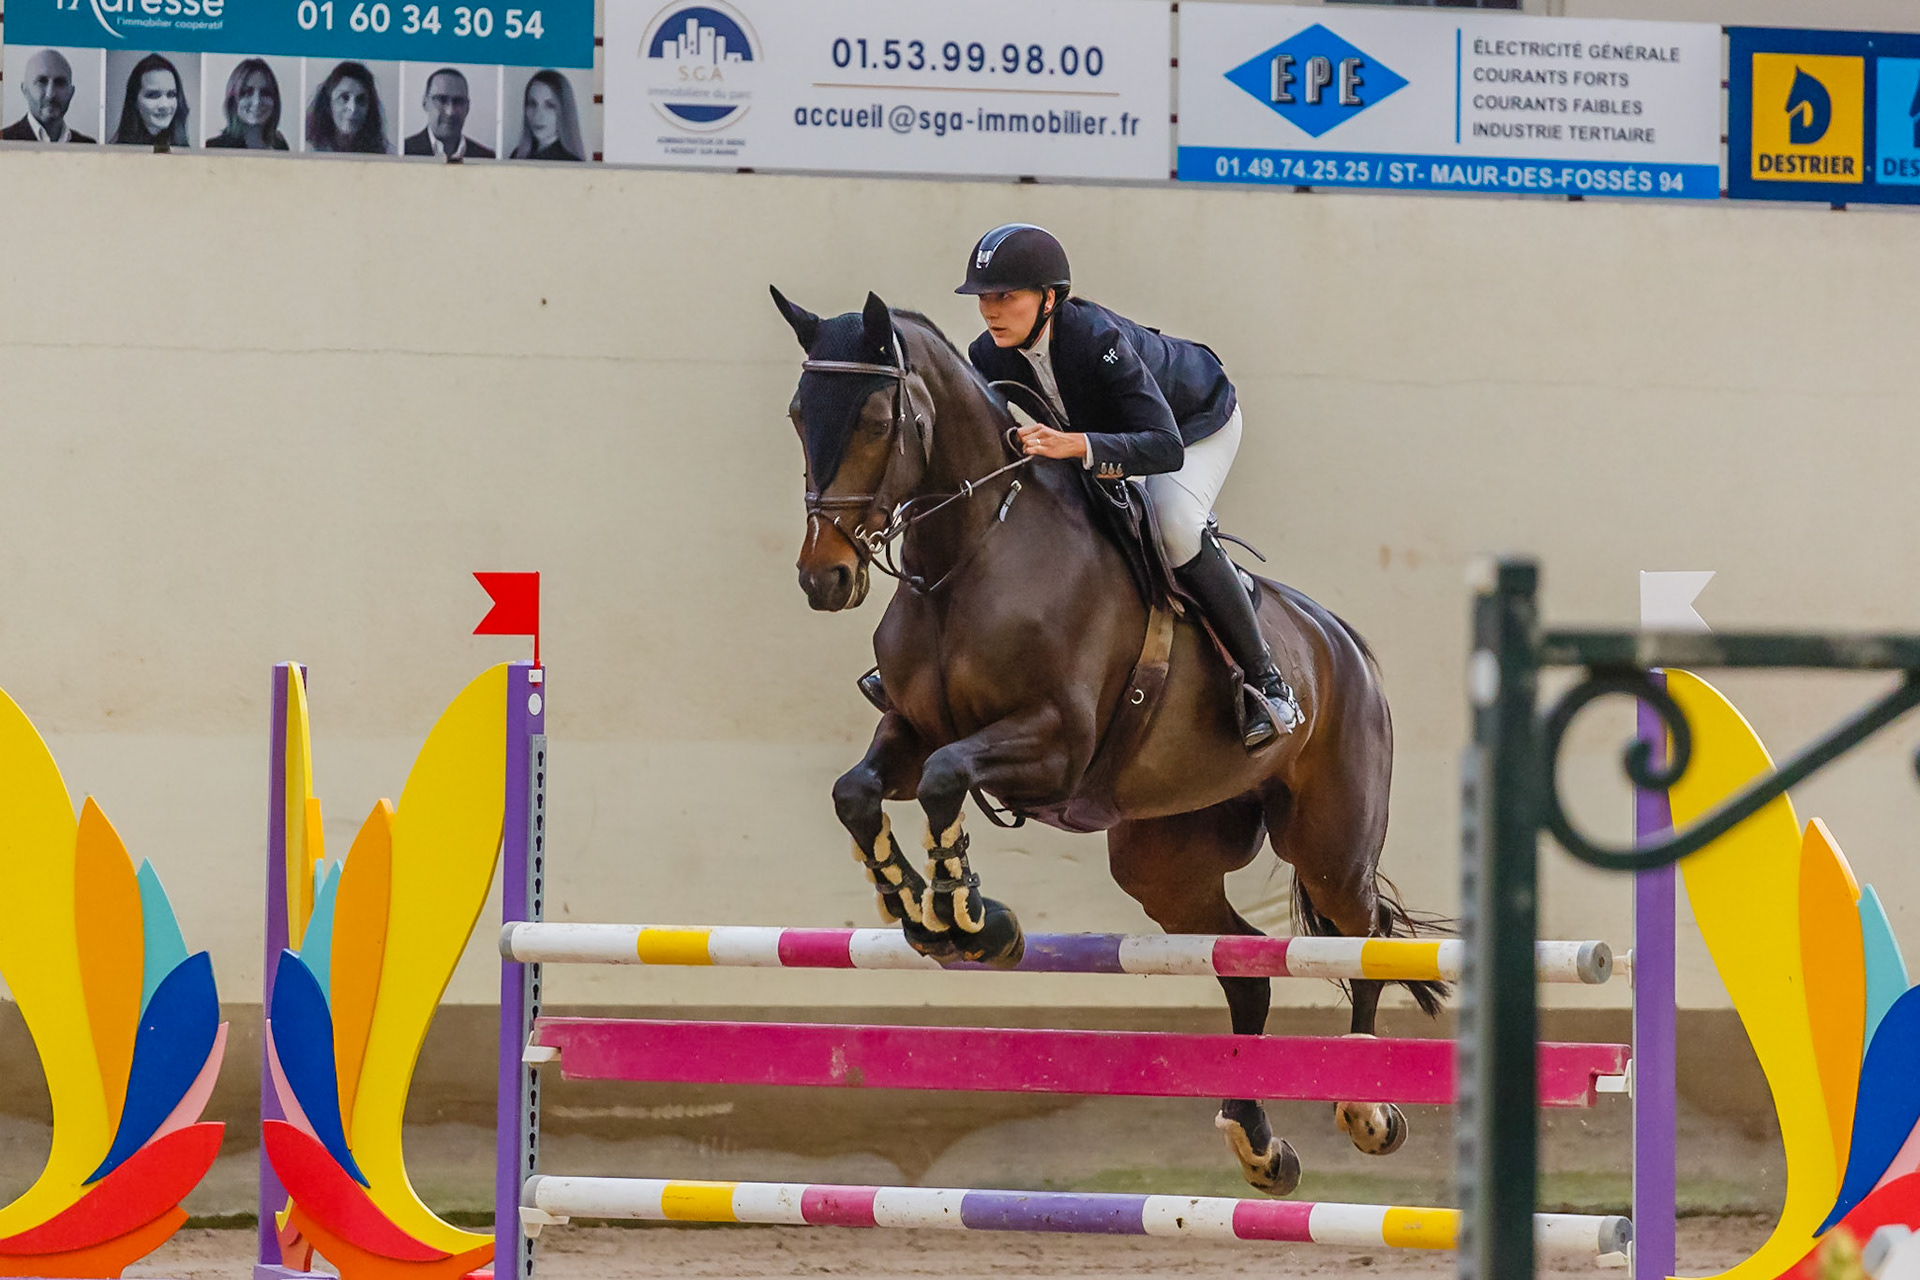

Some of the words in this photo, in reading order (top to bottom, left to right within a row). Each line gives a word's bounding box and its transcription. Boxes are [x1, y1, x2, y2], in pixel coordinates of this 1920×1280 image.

[297, 0, 333, 30] 01
[350, 3, 390, 33] 60
[402, 4, 441, 35] 34
[454, 6, 493, 38] 30
[505, 9, 544, 39] 54
[832, 38, 1104, 76] 01.53.99.98.00
[1473, 38, 1583, 59] ÉLECTRICITÉ
[1588, 43, 1680, 63] GÉNÉRALE
[1270, 54, 1363, 105] EPE
[1473, 67, 1568, 85] COURANTS
[1573, 70, 1629, 88] FORTS
[794, 102, 1140, 136] accueil@sga-immobilier.fr
[1473, 95, 1568, 113] COURANTS
[1573, 98, 1643, 115] FAIBLES
[1473, 122, 1563, 140] INDUSTRIE
[1569, 125, 1656, 143] TERTIAIRE
[1216, 155, 1370, 181] 01.49.74.25.25
[1431, 163, 1652, 192] MAUR-DES-FOSSÉS
[1659, 172, 1684, 192] 94
[1758, 153, 1854, 175] DESTRIER
